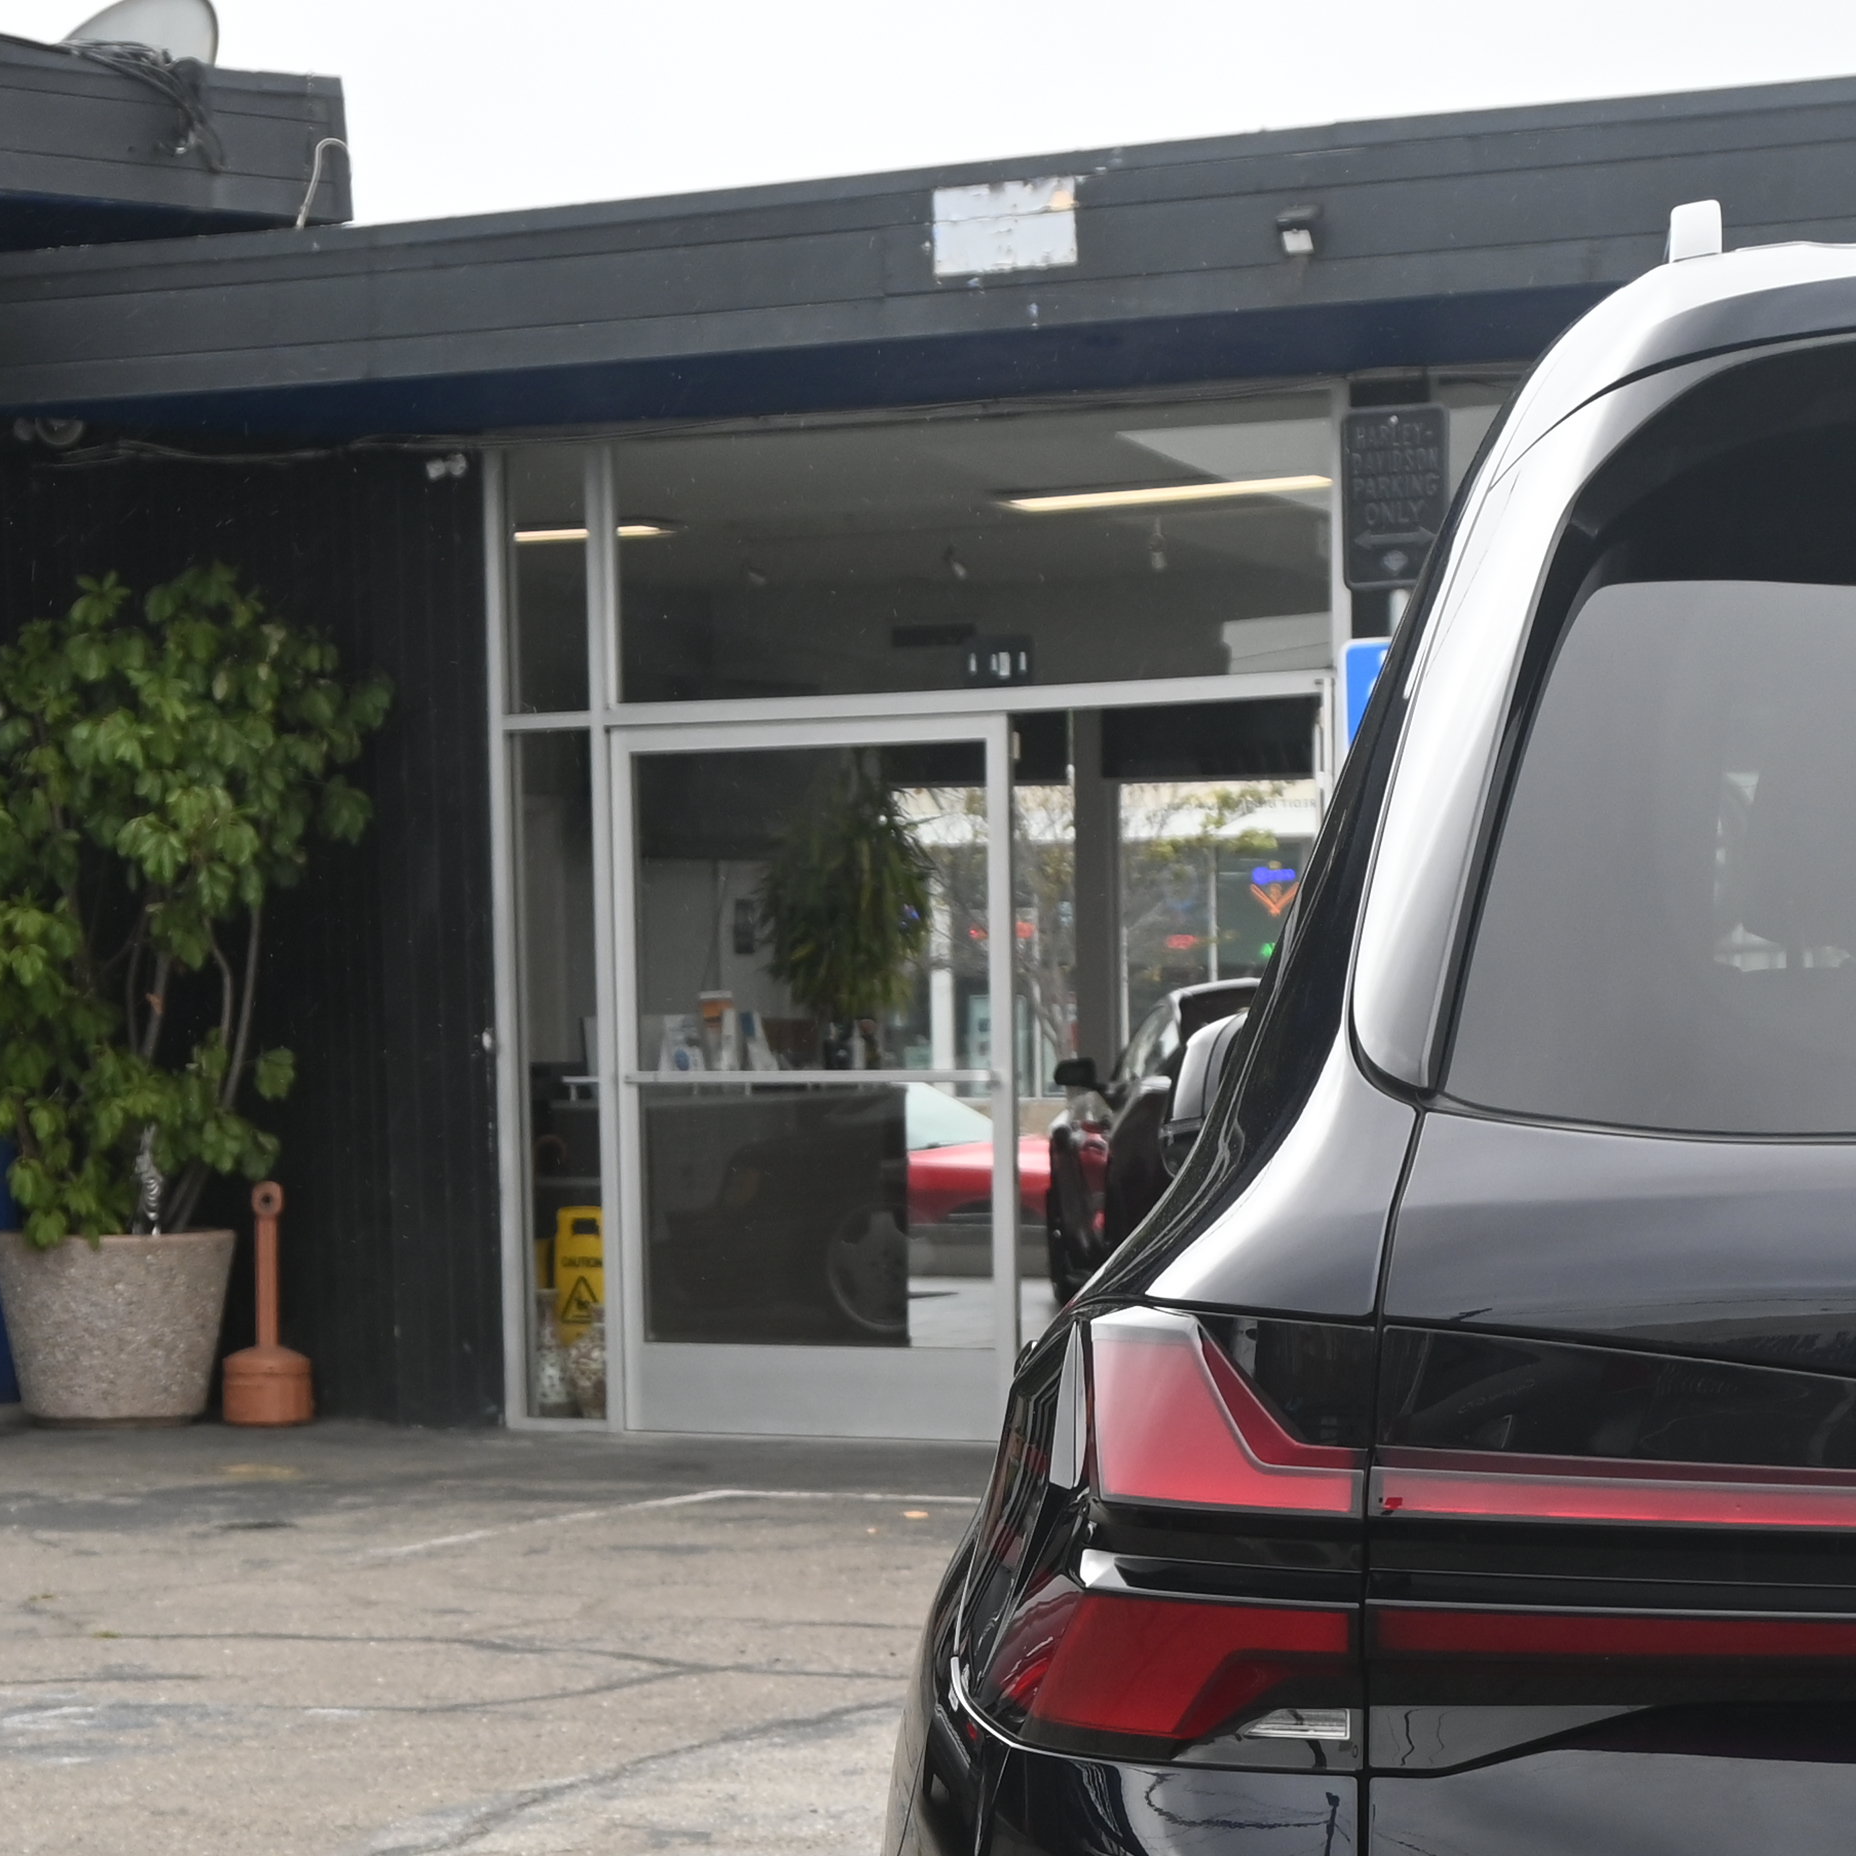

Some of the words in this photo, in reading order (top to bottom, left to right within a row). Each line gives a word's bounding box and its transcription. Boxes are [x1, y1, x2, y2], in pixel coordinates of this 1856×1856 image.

[1355, 422, 1433, 447] HARLEY-
[1351, 448, 1440, 474] DAVIDSON
[1352, 472, 1441, 500] PARKING
[1364, 499, 1425, 525] ONLY
